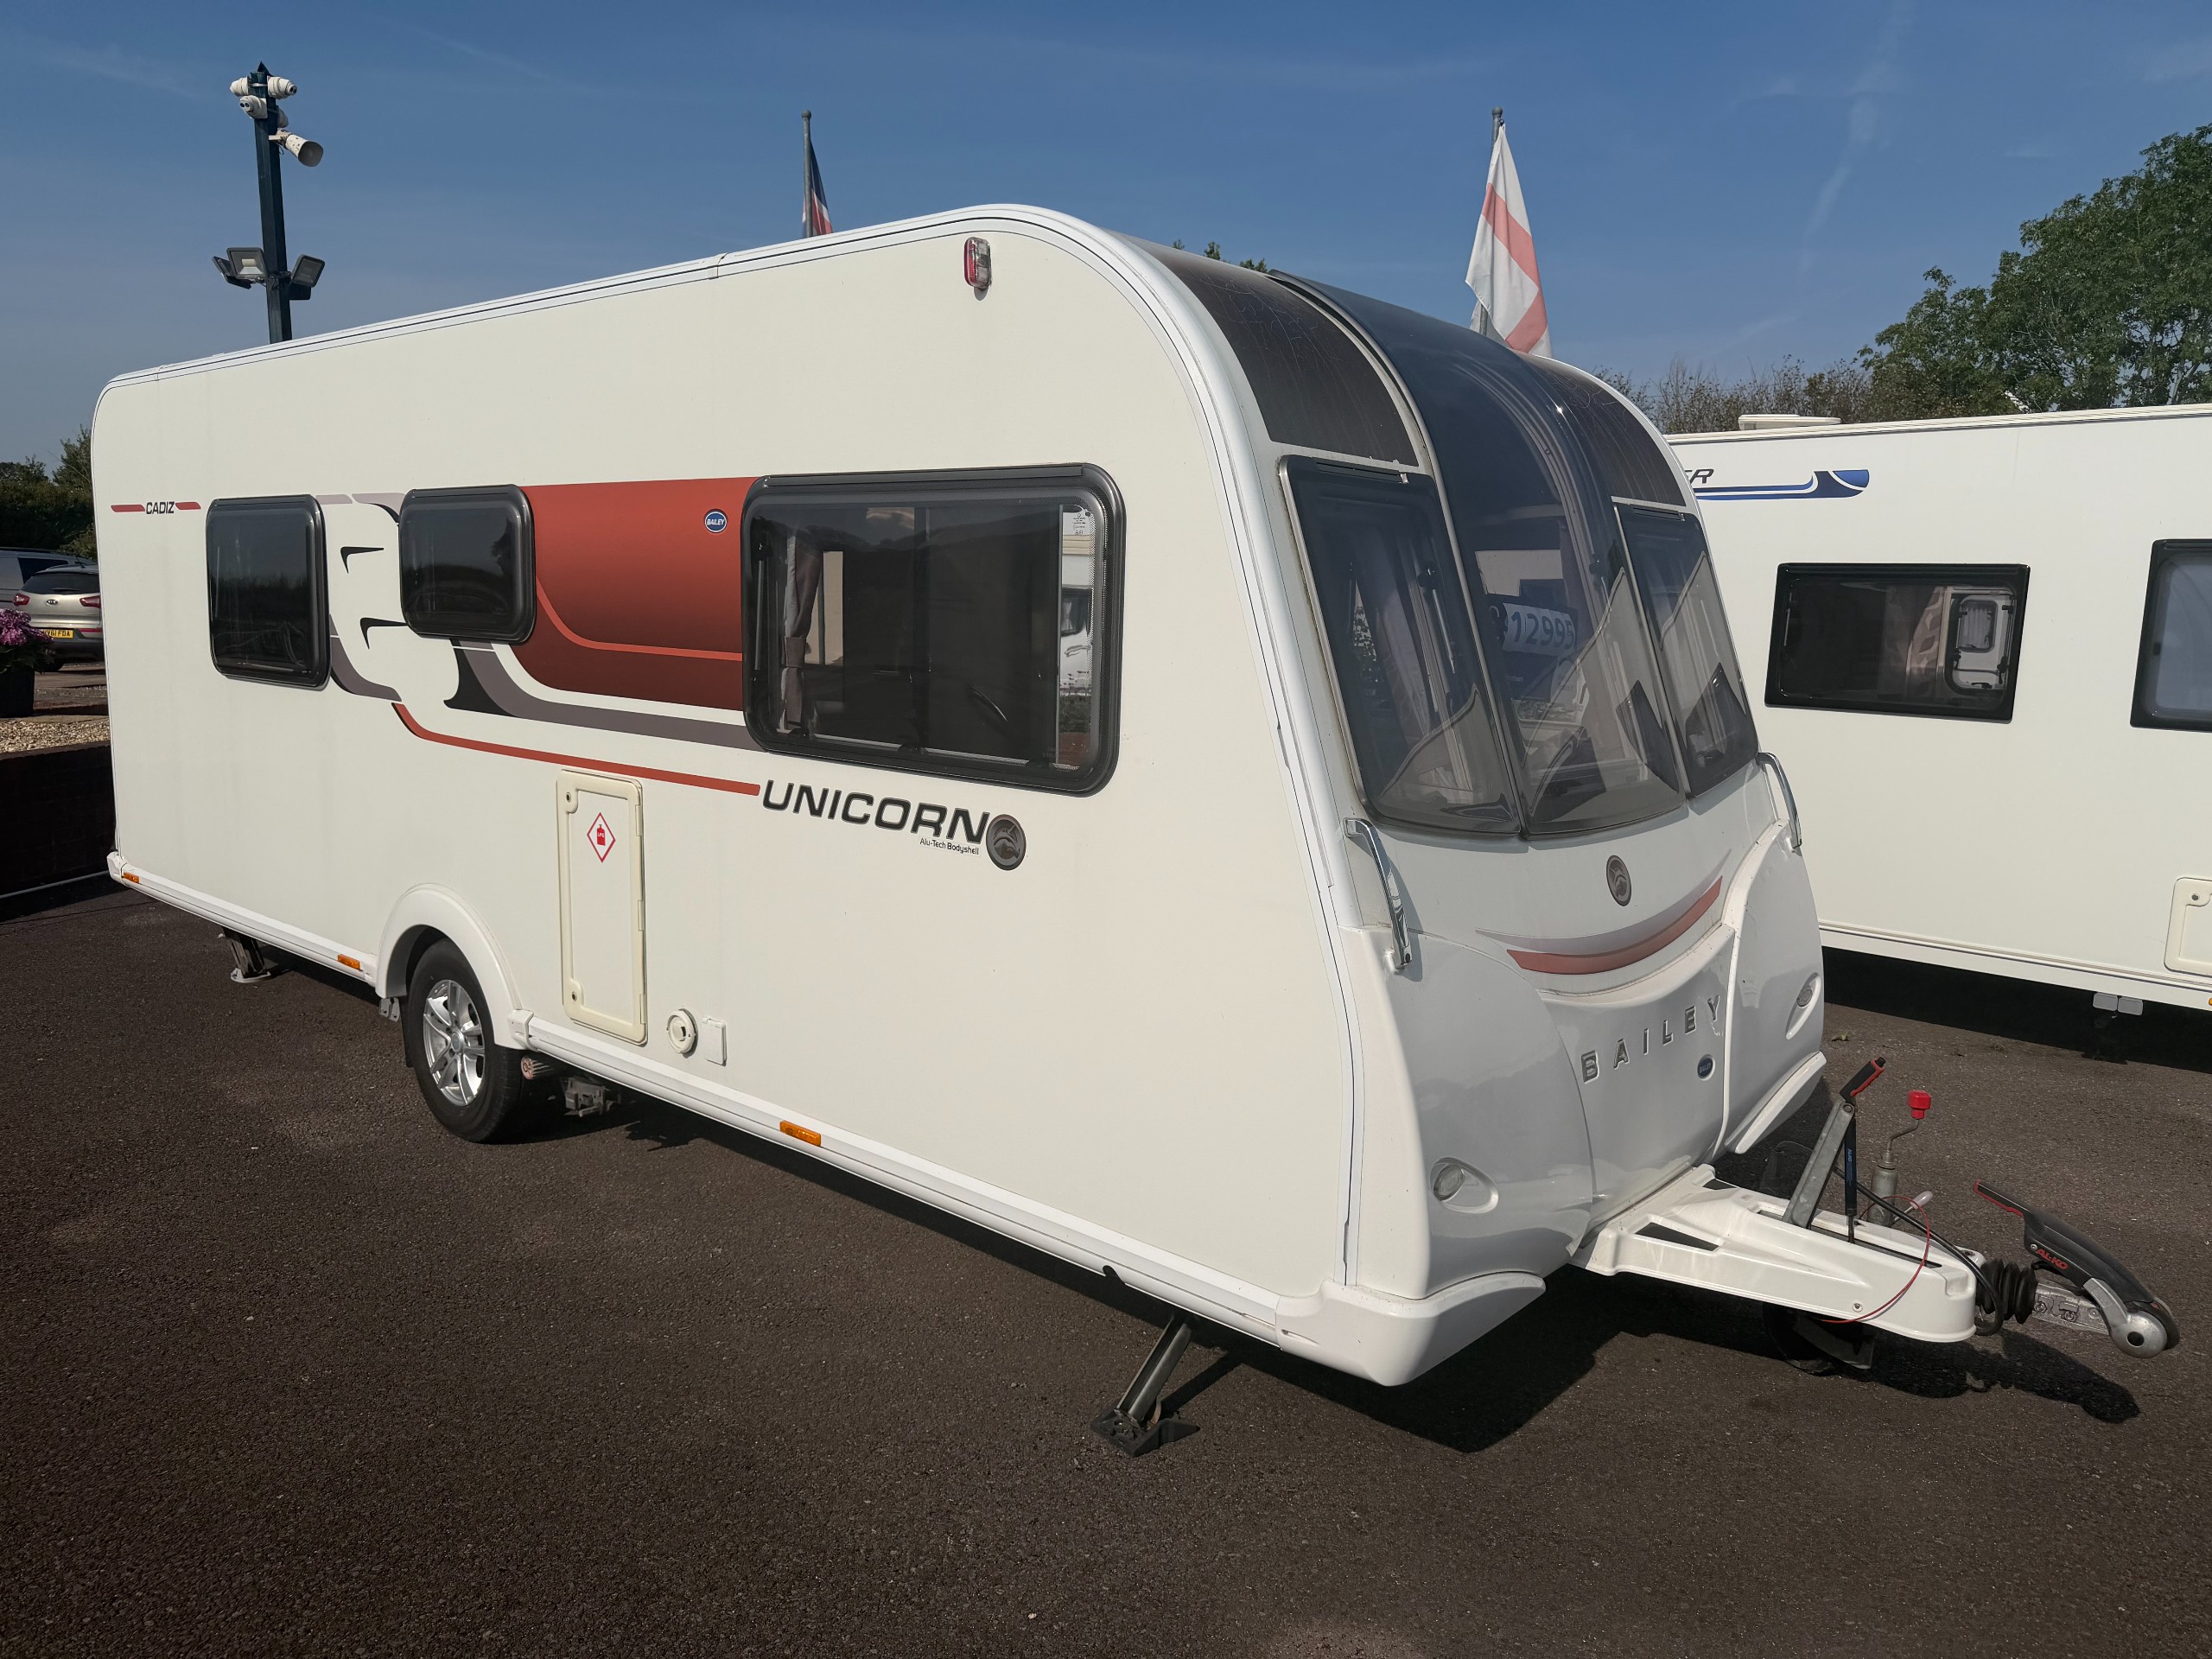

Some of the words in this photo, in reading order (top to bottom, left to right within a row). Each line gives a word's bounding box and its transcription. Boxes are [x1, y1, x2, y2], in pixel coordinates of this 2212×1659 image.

[1685, 469, 1714, 484] R
[146, 501, 175, 514] CADIZ
[763, 779, 990, 843] UNICORN
[919, 837, 946, 849] Alu-Tech
[947, 842, 979, 855] Bodyshell
[1580, 995, 1720, 1085] BAILEY
[2036, 1249, 2069, 1269] AL-KO
